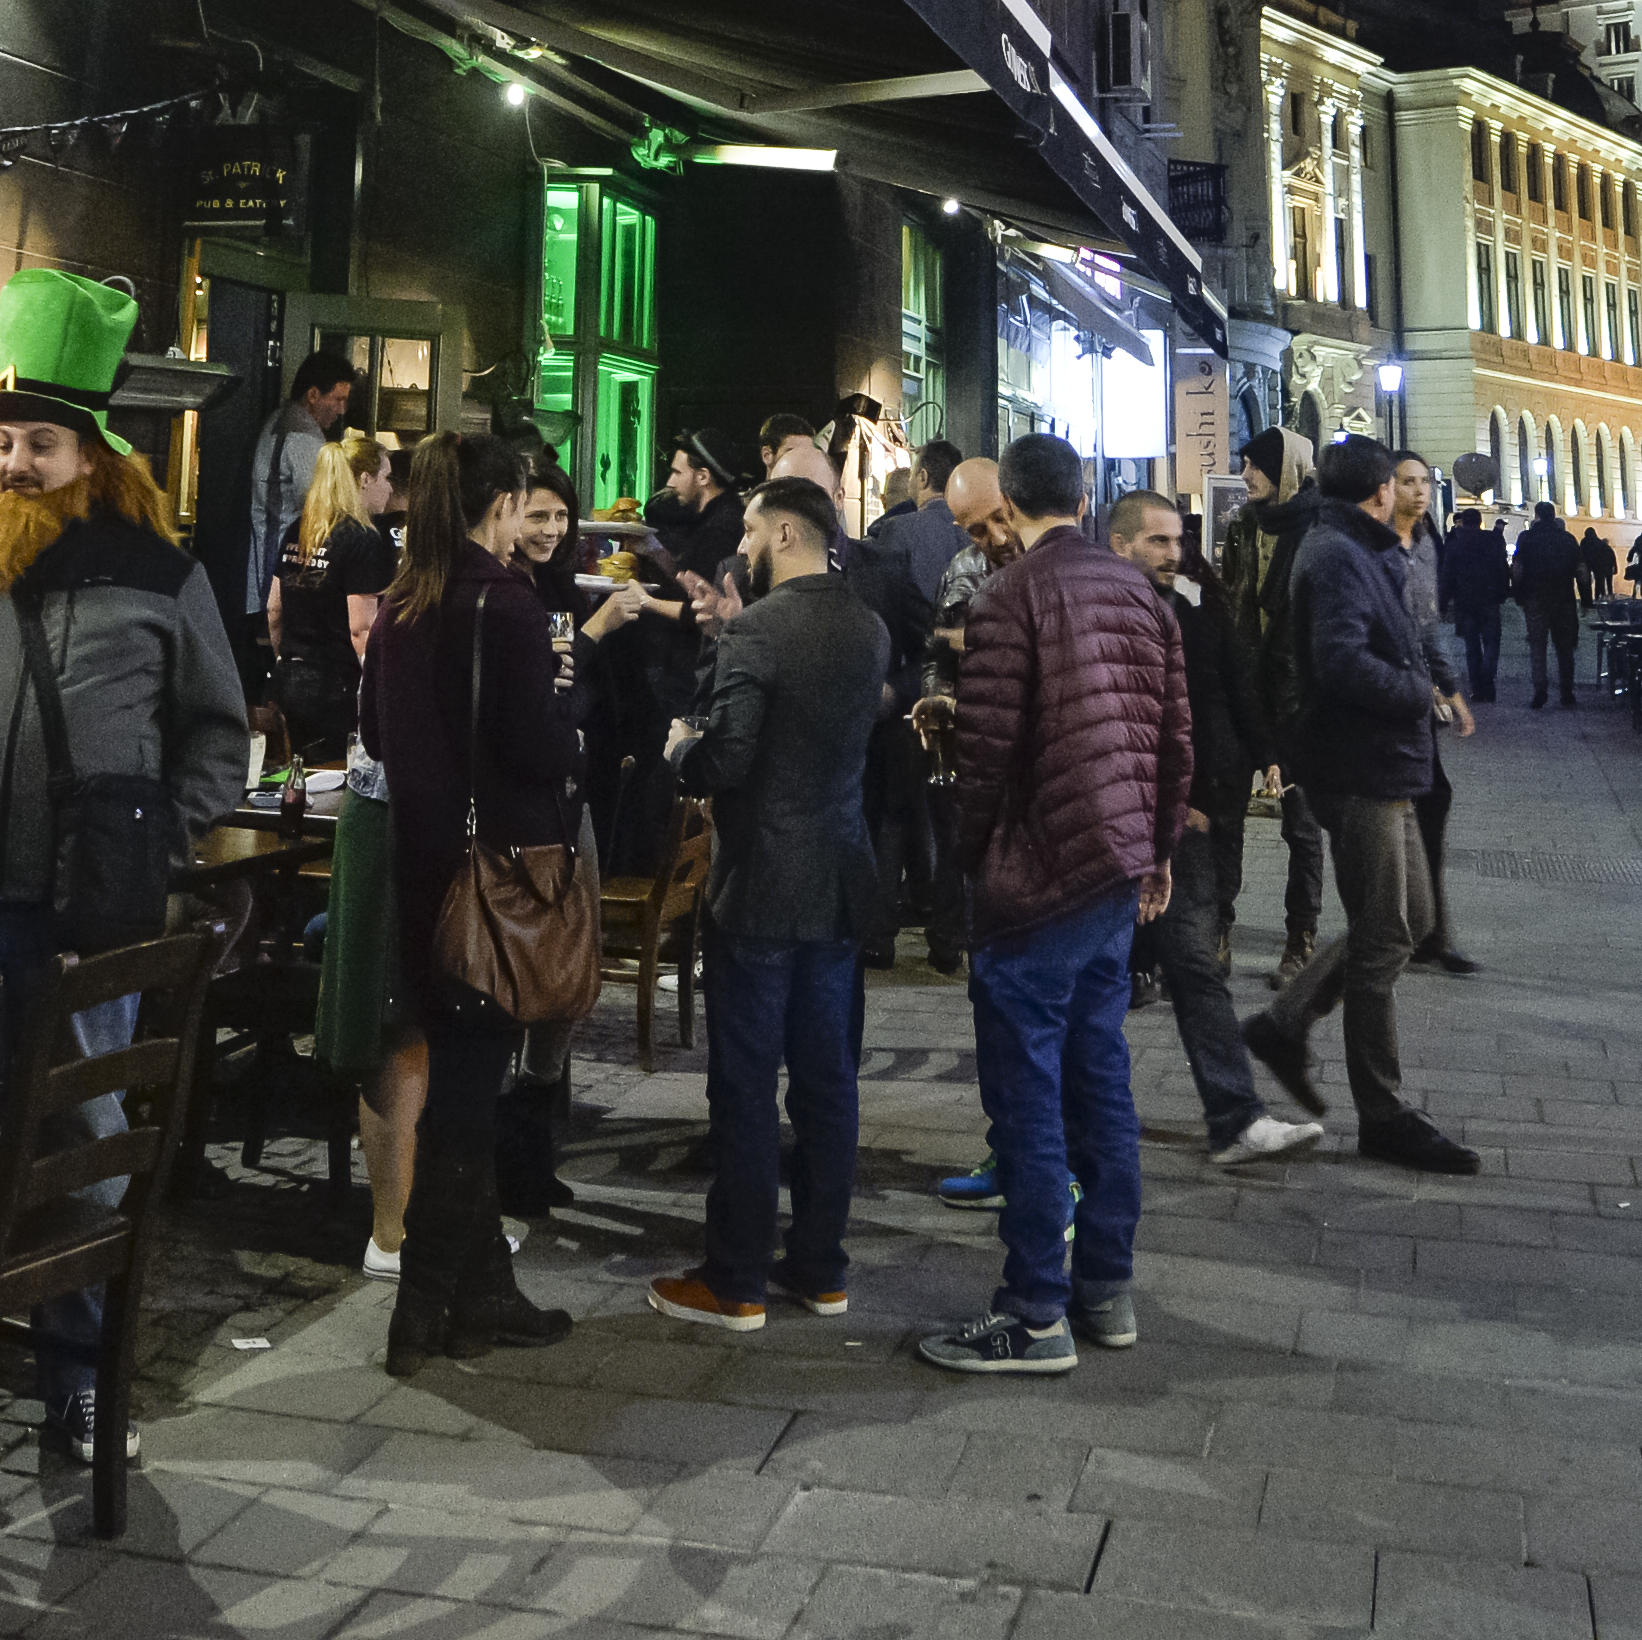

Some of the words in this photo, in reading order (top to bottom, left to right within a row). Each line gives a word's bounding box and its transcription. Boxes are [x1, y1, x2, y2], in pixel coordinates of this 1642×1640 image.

[196, 199, 221, 209] PUB
[225, 198, 234, 208] &
[239, 199, 287, 209] EATY
